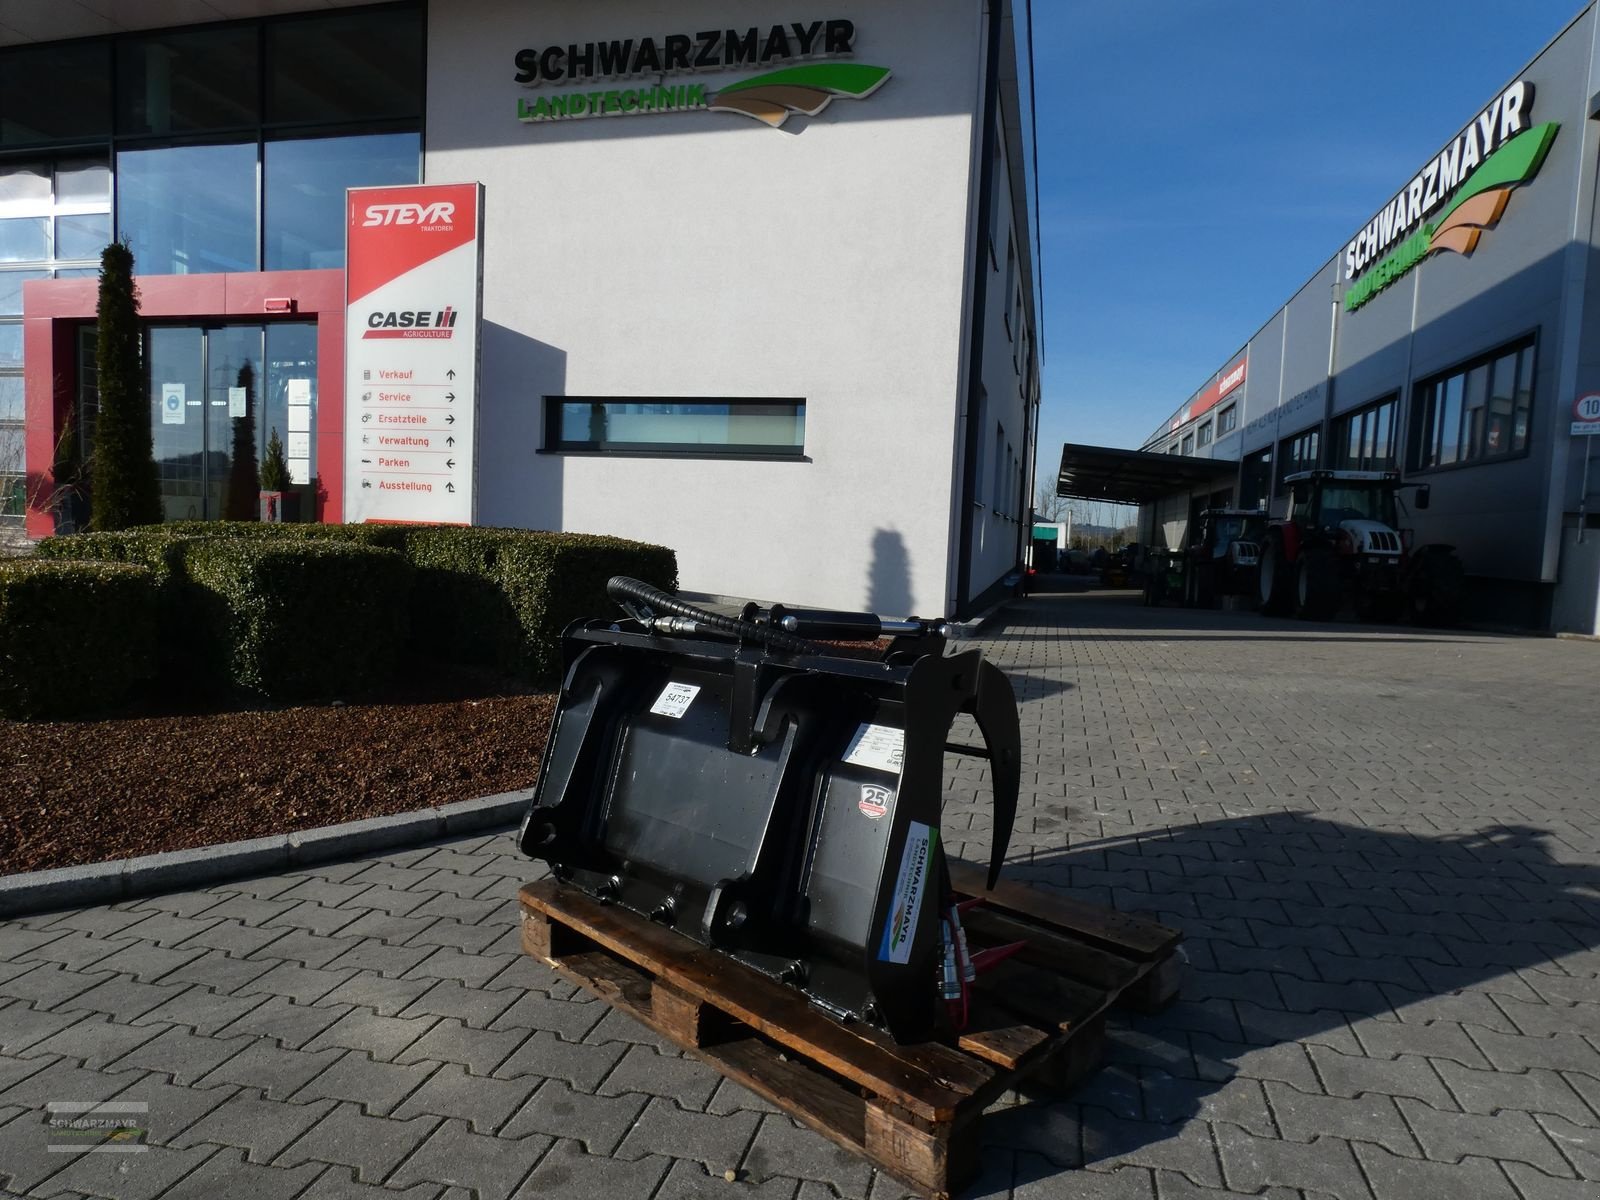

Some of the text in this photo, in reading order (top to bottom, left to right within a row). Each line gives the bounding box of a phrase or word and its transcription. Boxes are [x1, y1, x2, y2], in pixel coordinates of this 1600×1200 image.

[514, 19, 855, 84] SCHWARZMAYR
[517, 83, 707, 121] LANDTECHNIK
[1345, 80, 1534, 279] SCHWARZMAYR
[362, 202, 455, 227] STEYR
[368, 311, 431, 328] CASE
[379, 370, 413, 379] Verkauf
[379, 393, 411, 401] Service
[379, 415, 427, 424] Ersatzteile
[379, 436, 429, 447] Verwaltung
[379, 458, 410, 467] Parken
[379, 481, 432, 493] Ausstellung
[665, 693, 690, 704] 54737
[863, 789, 886, 806] 25
[899, 839, 929, 943] SCHWARZMAYR
